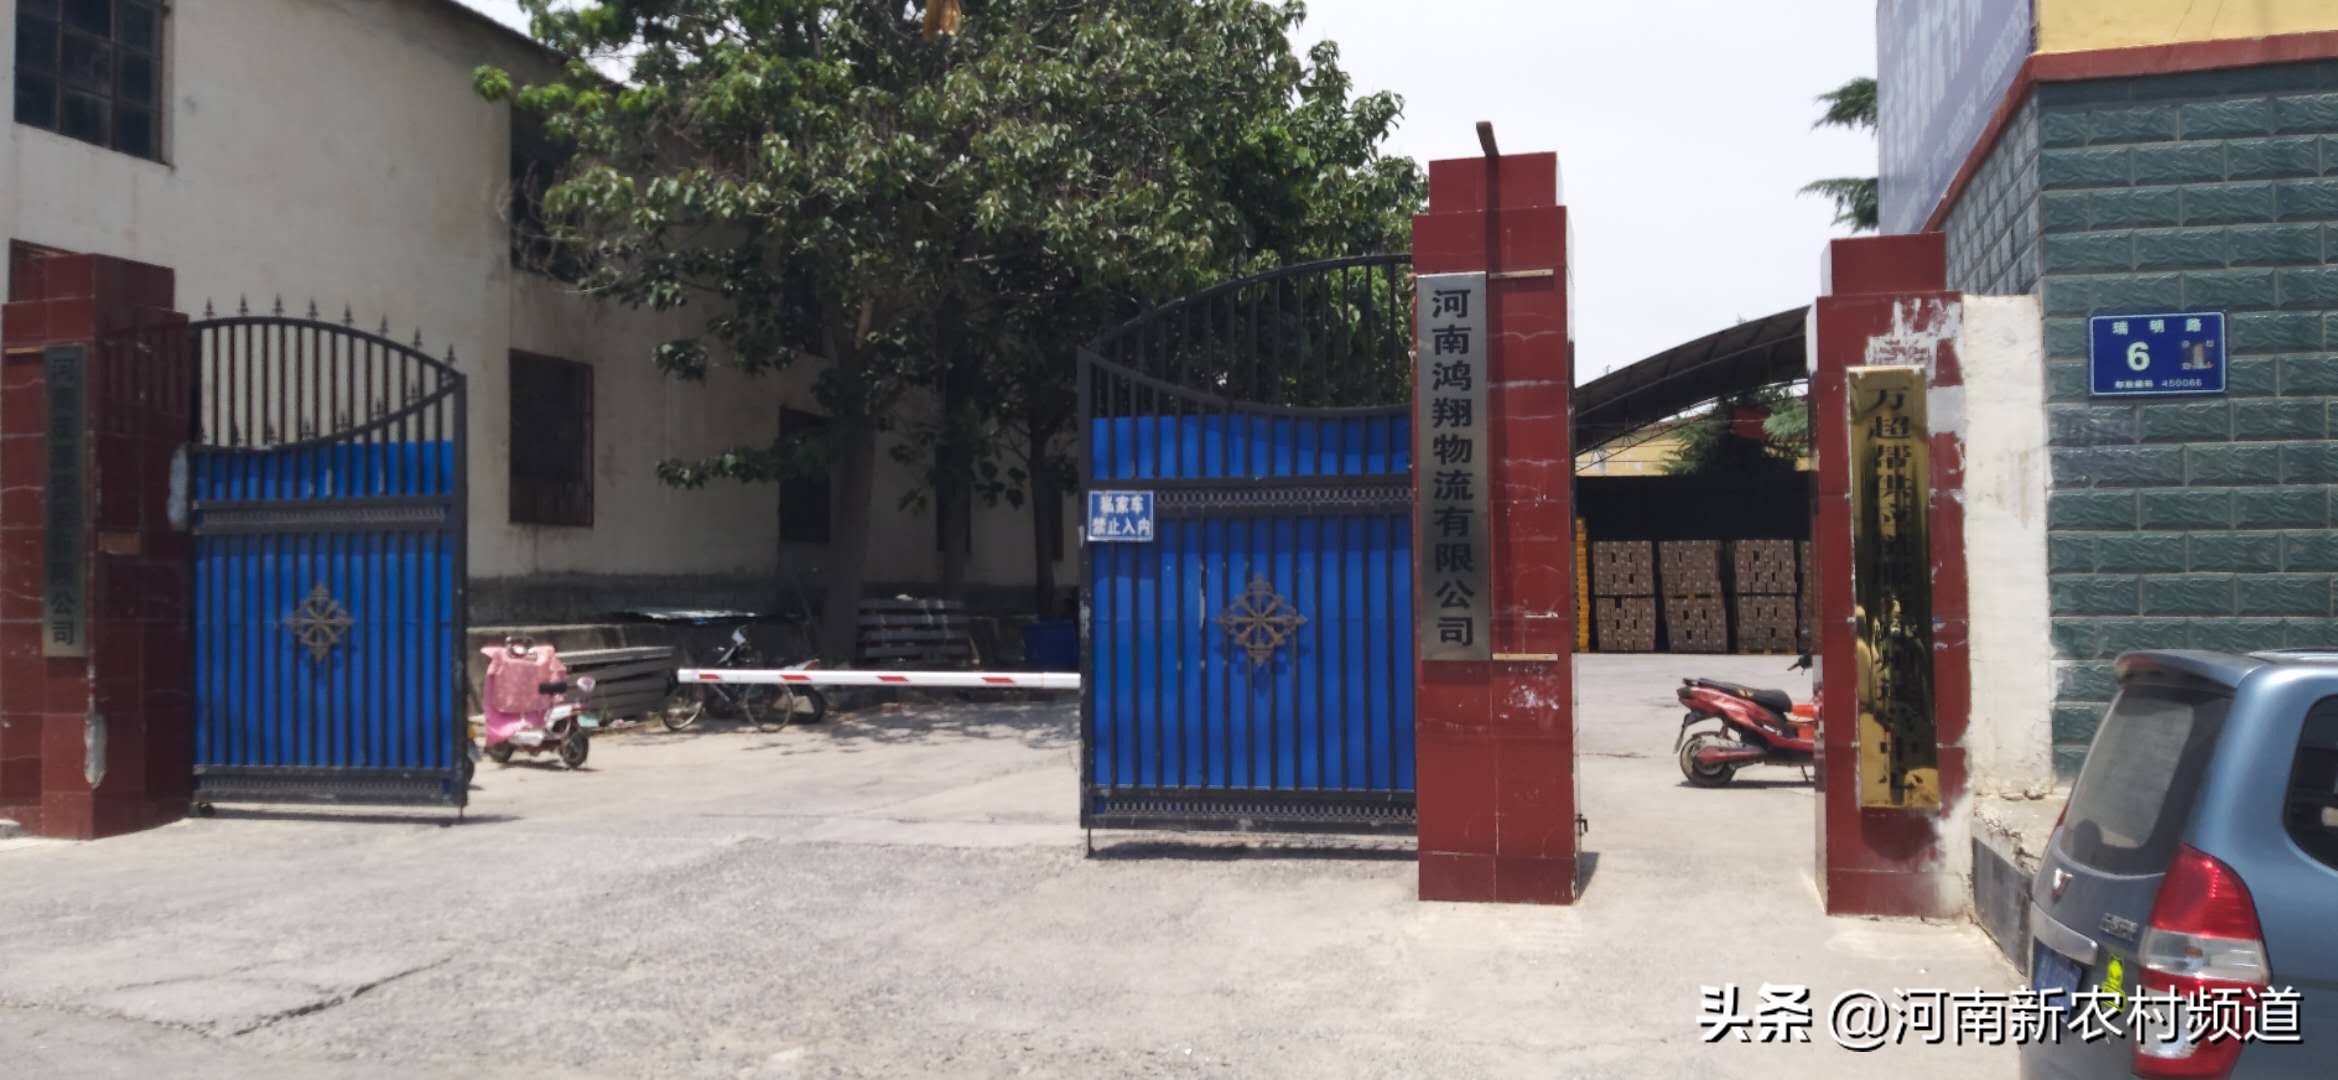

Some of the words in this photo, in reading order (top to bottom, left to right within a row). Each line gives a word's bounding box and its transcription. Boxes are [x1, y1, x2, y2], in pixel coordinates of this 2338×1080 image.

[2127, 341, 2150, 371] 6
[1432, 288, 1475, 647] 河南鸿翔物流有限公司
[1092, 517, 1150, 535] 禁止入内
